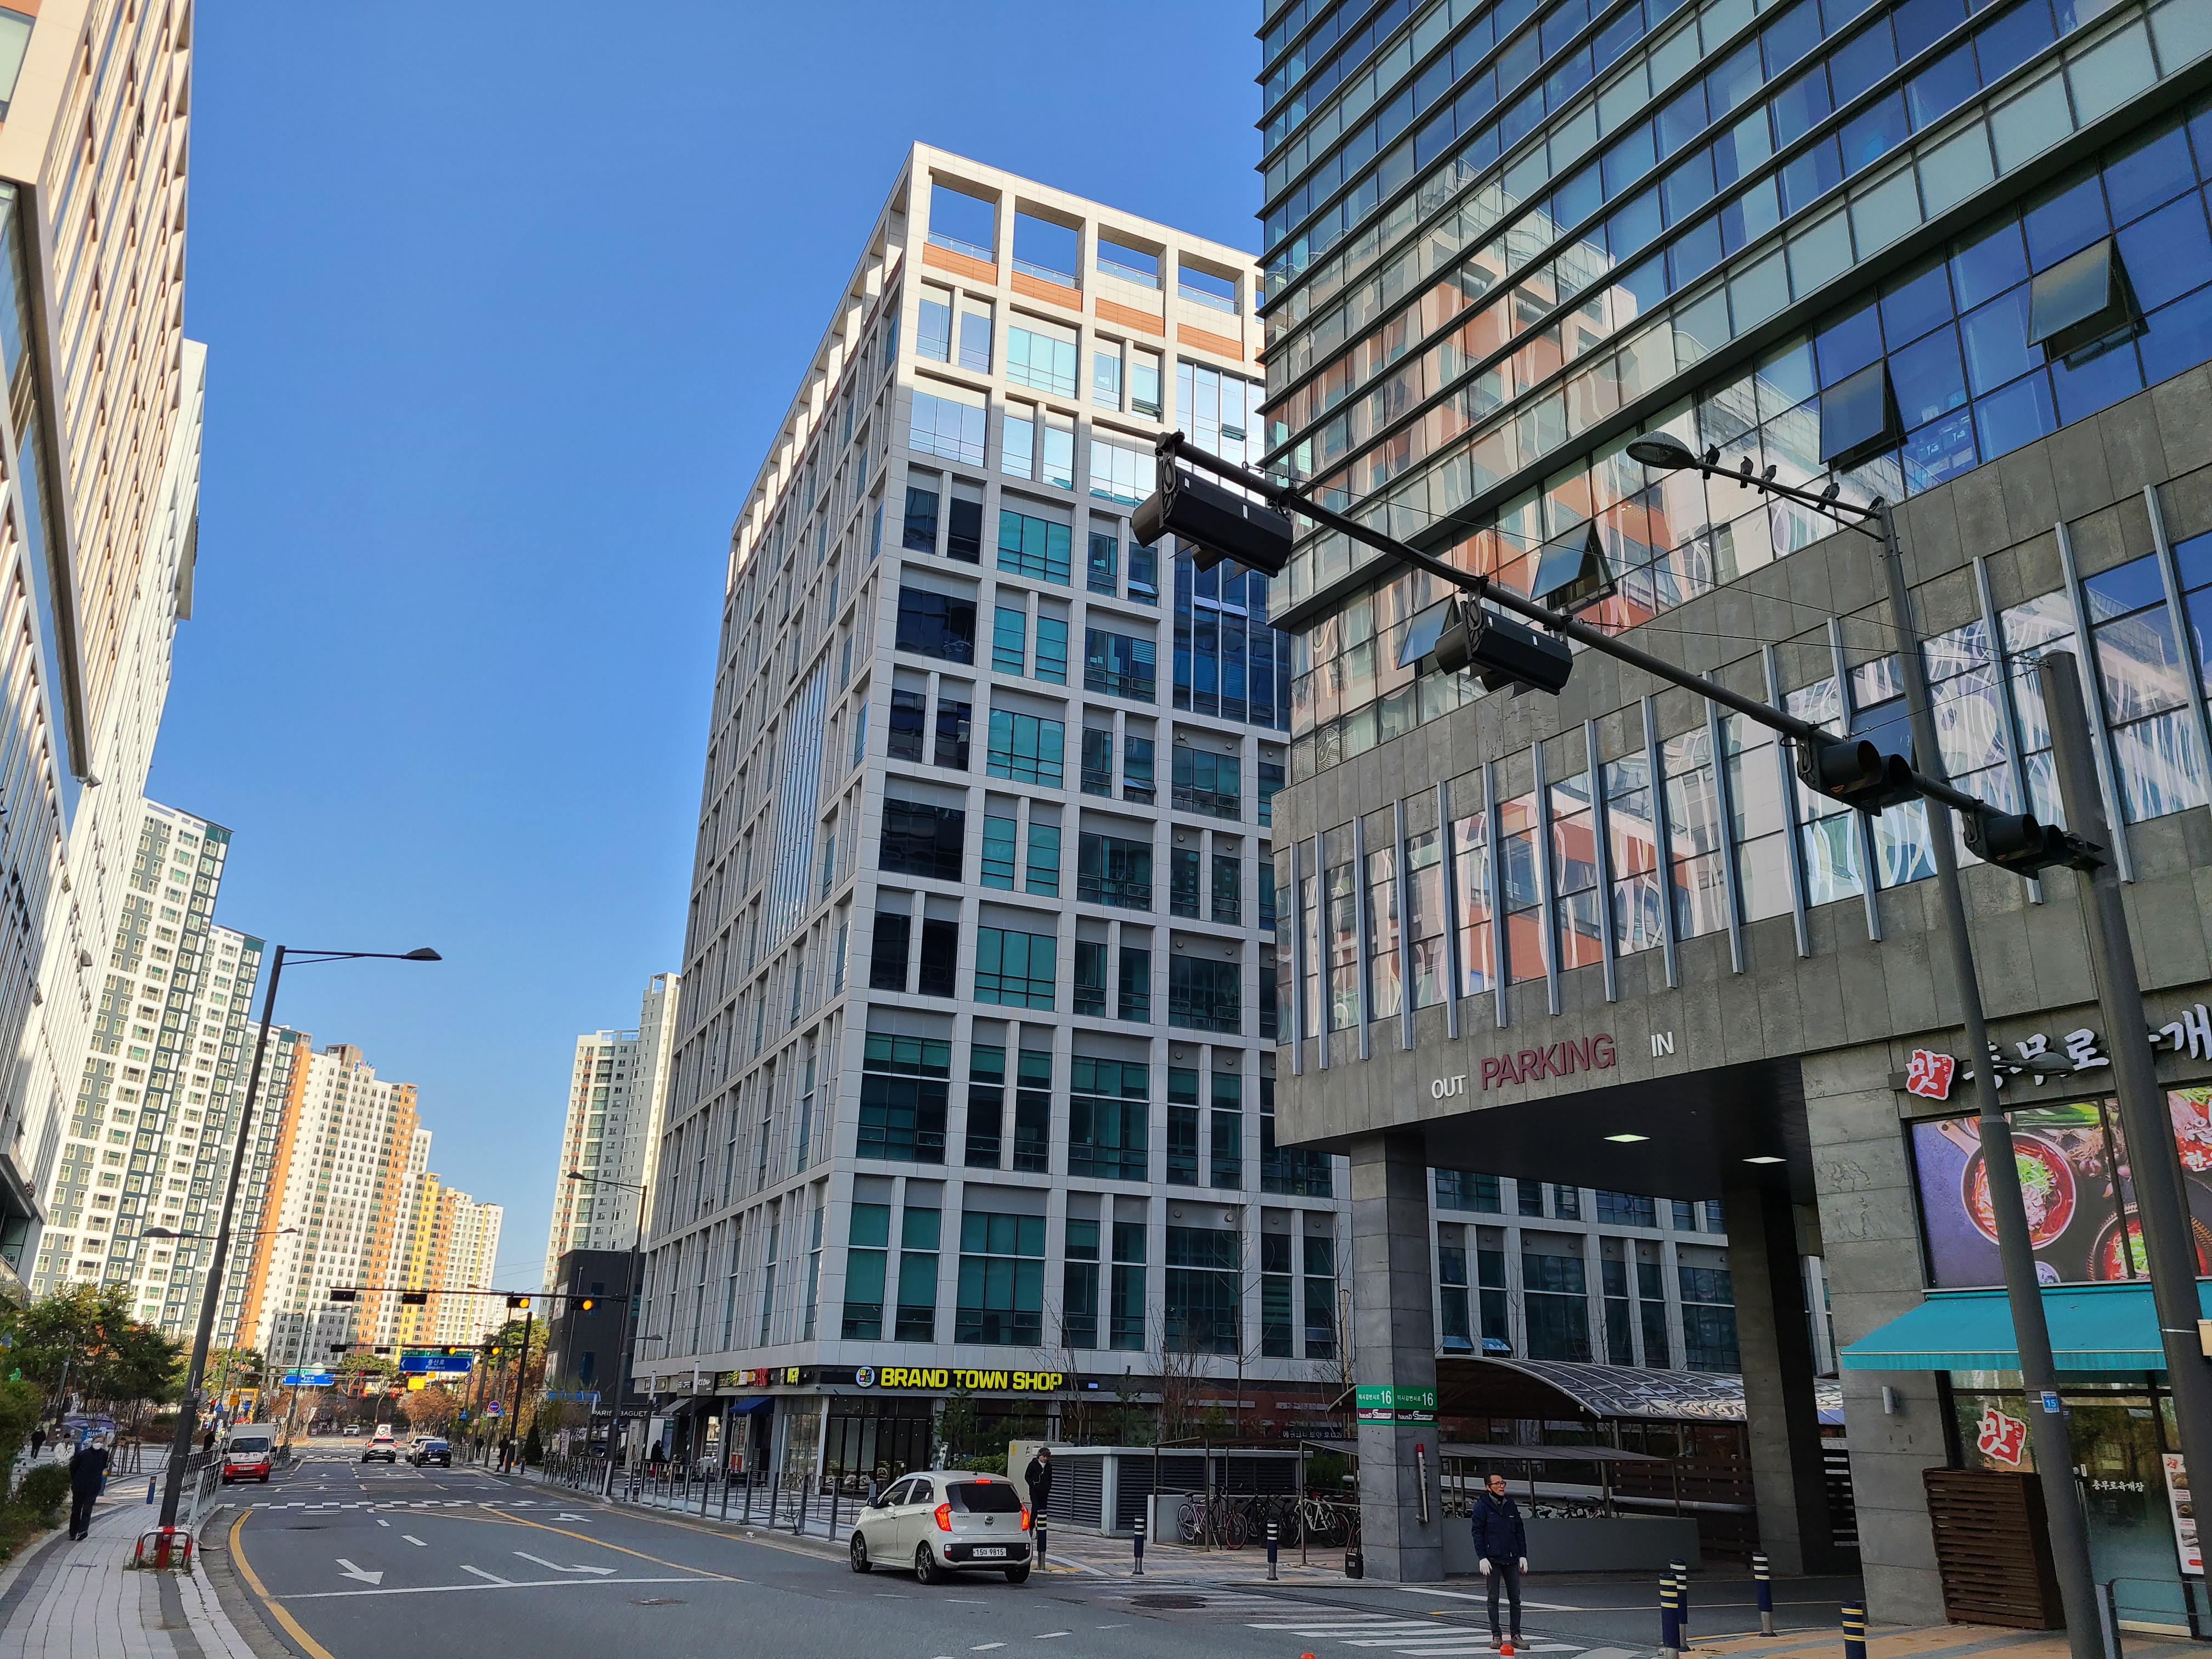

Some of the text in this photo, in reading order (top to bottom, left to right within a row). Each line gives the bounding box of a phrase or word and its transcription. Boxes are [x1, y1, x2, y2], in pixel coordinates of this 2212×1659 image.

[1651, 1031, 1675, 1057] IN
[1481, 1033, 1616, 1090] PARKING
[1431, 1075, 1466, 1099] OUT
[880, 1368, 1063, 1391] BRAND TOWN SHOP
[1381, 1390, 1392, 1404] 16
[1422, 1392, 1434, 1406] 16
[2046, 1400, 2057, 1408] 15
[2091, 1479, 2145, 1492] 충무로육개장
